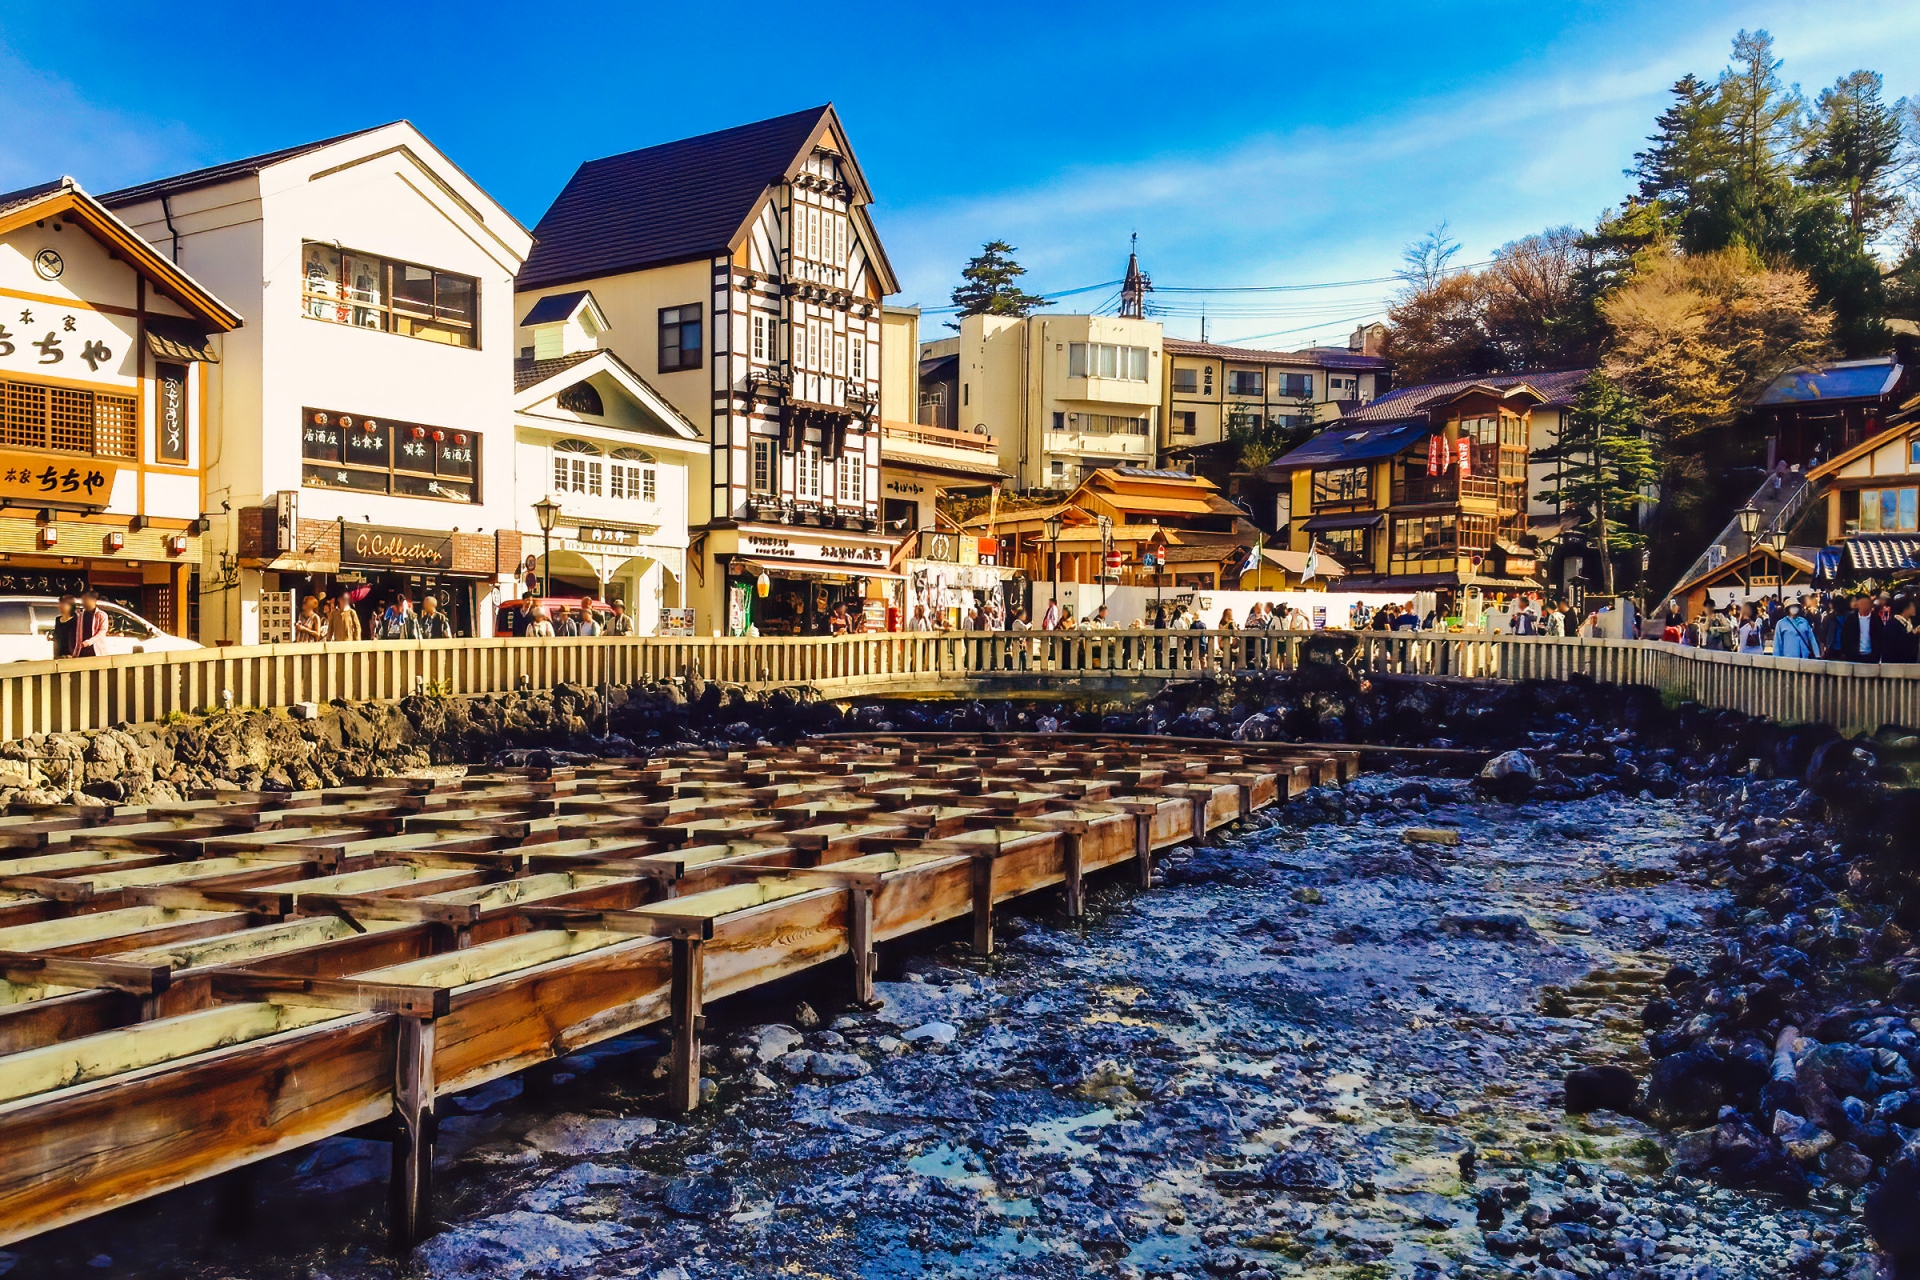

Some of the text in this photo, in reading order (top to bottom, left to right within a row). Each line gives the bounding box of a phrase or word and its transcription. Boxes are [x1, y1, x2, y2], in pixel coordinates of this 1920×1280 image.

[19, 308, 77, 332] 本家
[303, 428, 339, 446] 居酒屋
[351, 434, 383, 450] お食事
[402, 442, 426, 457] 喫茶
[442, 447, 473, 463] 居酒屋
